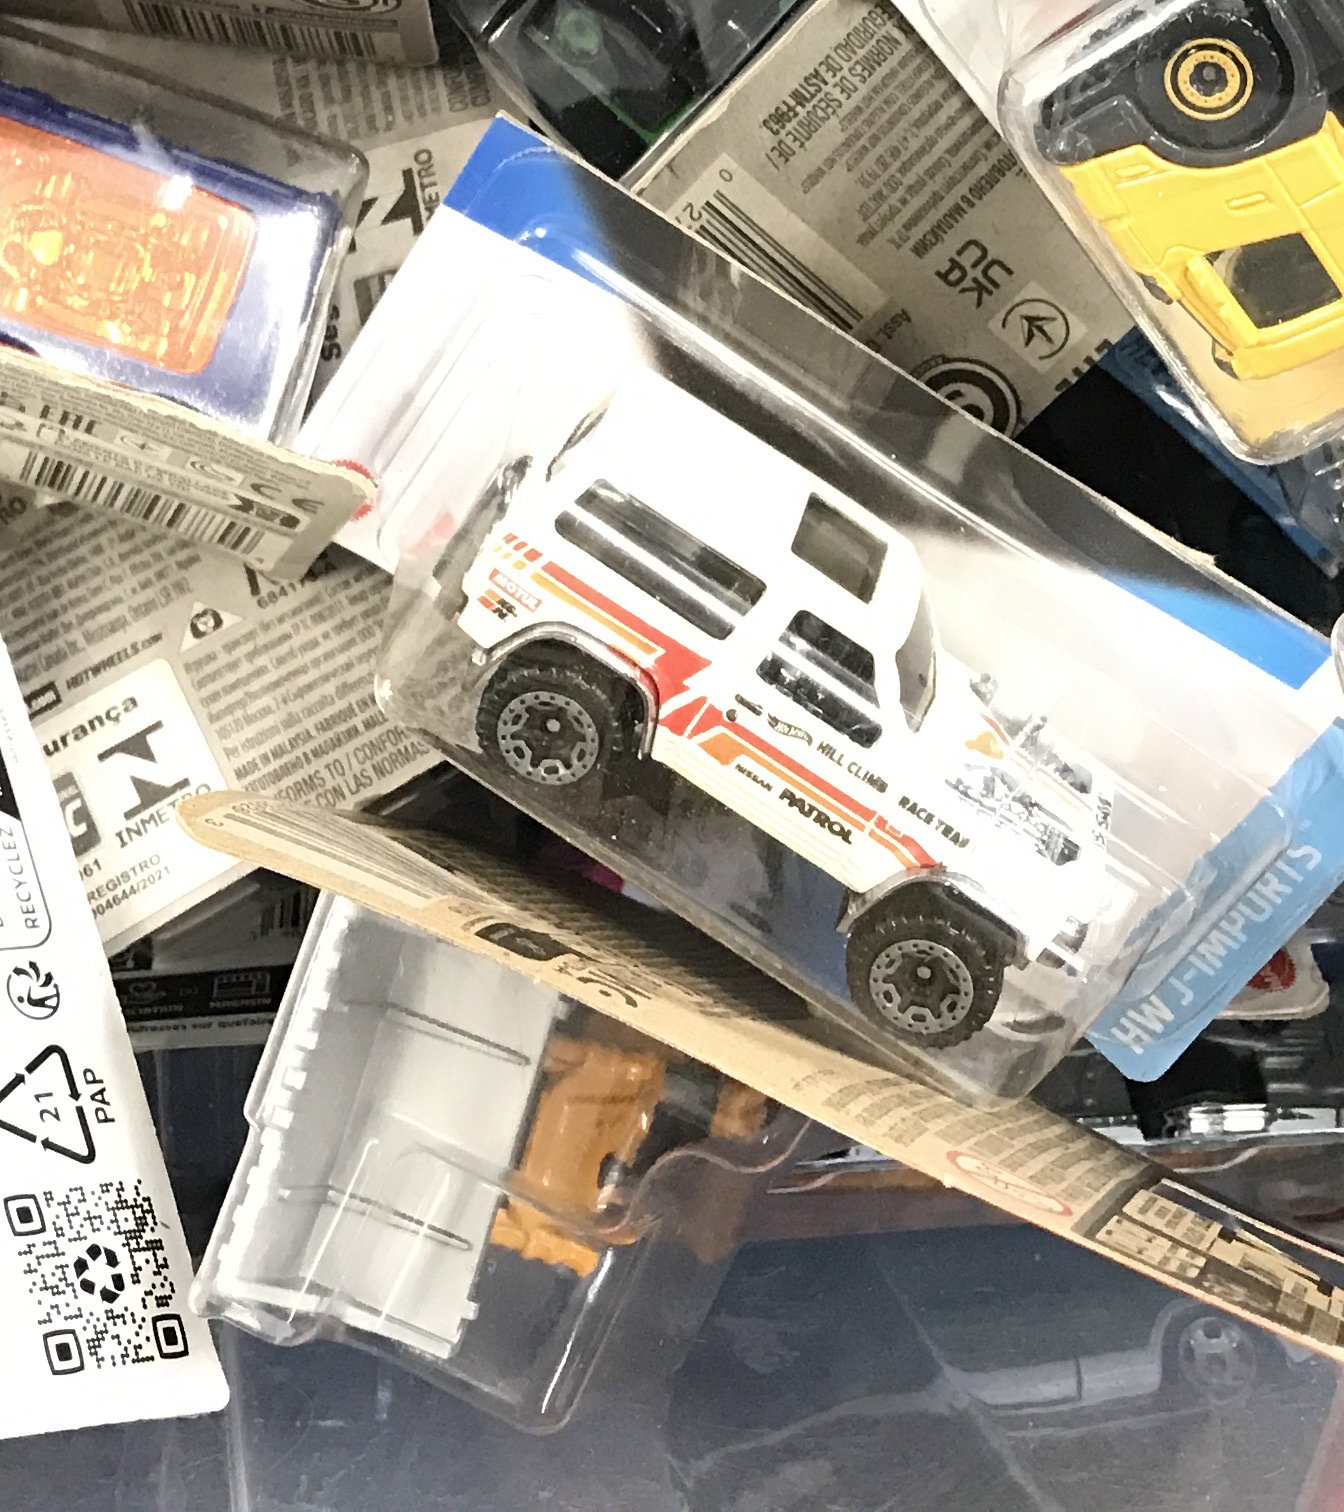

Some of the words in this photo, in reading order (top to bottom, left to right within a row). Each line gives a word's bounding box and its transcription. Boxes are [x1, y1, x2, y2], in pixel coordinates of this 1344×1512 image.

[845, 27, 902, 86] NORMES
[786, 66, 830, 111] ASTM
[933, 233, 991, 293] CA
[957, 253, 1014, 312] UK
[38, 693, 143, 758] urança
[342, 766, 372, 794] LAS
[816, 740, 849, 768] HILL
[896, 794, 934, 825] RACE
[777, 787, 857, 848] PATROL
[81, 852, 165, 904] REGISTRO
[1108, 986, 1179, 1058] HW
[1160, 827, 1325, 1015] J-IMPORTS
[33, 1089, 61, 1125] 21
[81, 1064, 116, 1127] PAP
